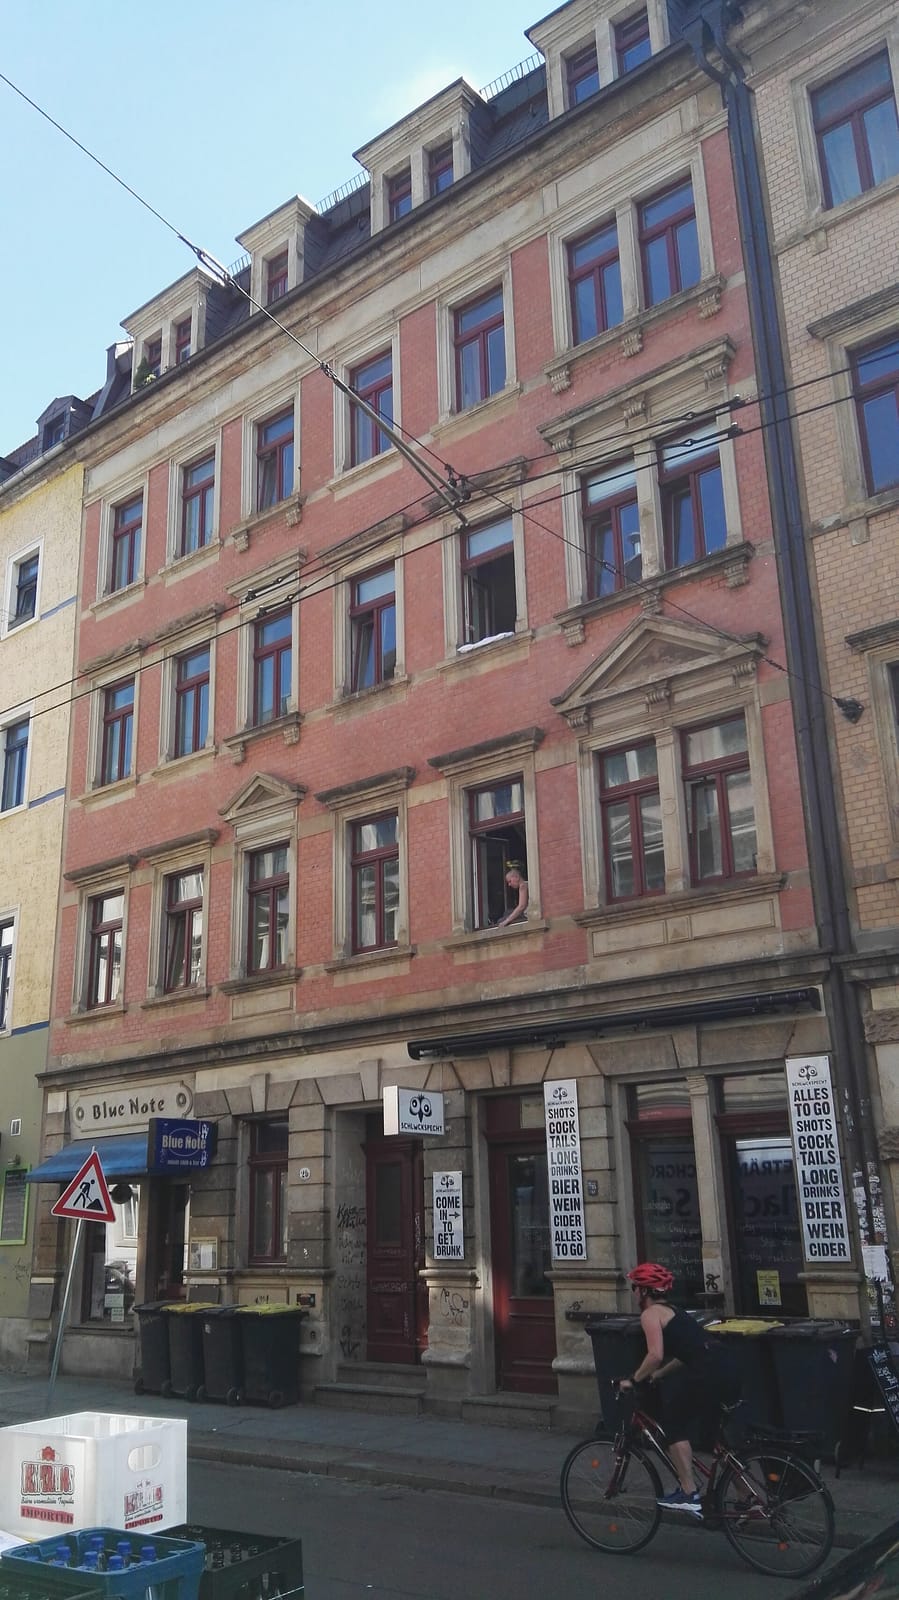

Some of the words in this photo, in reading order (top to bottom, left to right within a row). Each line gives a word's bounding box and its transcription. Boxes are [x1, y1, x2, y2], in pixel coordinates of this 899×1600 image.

[794, 1088, 829, 1102] ALLES
[93, 1101, 125, 1120] Blue
[129, 1097, 165, 1114] Note
[548, 1107, 575, 1119] SHOTS
[794, 1103, 811, 1117] TO
[813, 1101, 831, 1115] GO
[549, 1120, 576, 1134] COCK
[797, 1119, 832, 1132] SHOTS
[162, 1135, 184, 1148] Blue
[185, 1135, 206, 1150] Note
[550, 1135, 577, 1148] TAILS
[798, 1134, 835, 1150] COCK
[550, 1151, 578, 1165] LONG
[800, 1150, 836, 1166] TAILS
[551, 1166, 579, 1176] DRINKS
[802, 1169, 838, 1185] LONG
[552, 1179, 580, 1195] BIER
[803, 1186, 840, 1198] DRINKS
[436, 1196, 461, 1209] COME
[553, 1197, 581, 1212] WEIN
[440, 1210, 448, 1221] IN
[804, 1202, 843, 1220] BIER
[443, 1221, 453, 1233] TO
[554, 1214, 581, 1227] CIDER
[555, 1230, 583, 1242] ALLES
[807, 1223, 845, 1239] WEIN
[438, 1233, 455, 1245] GET
[436, 1245, 462, 1257] DRUNK
[555, 1243, 568, 1256] TO
[570, 1243, 583, 1256] GO
[809, 1242, 847, 1257] CIDER
